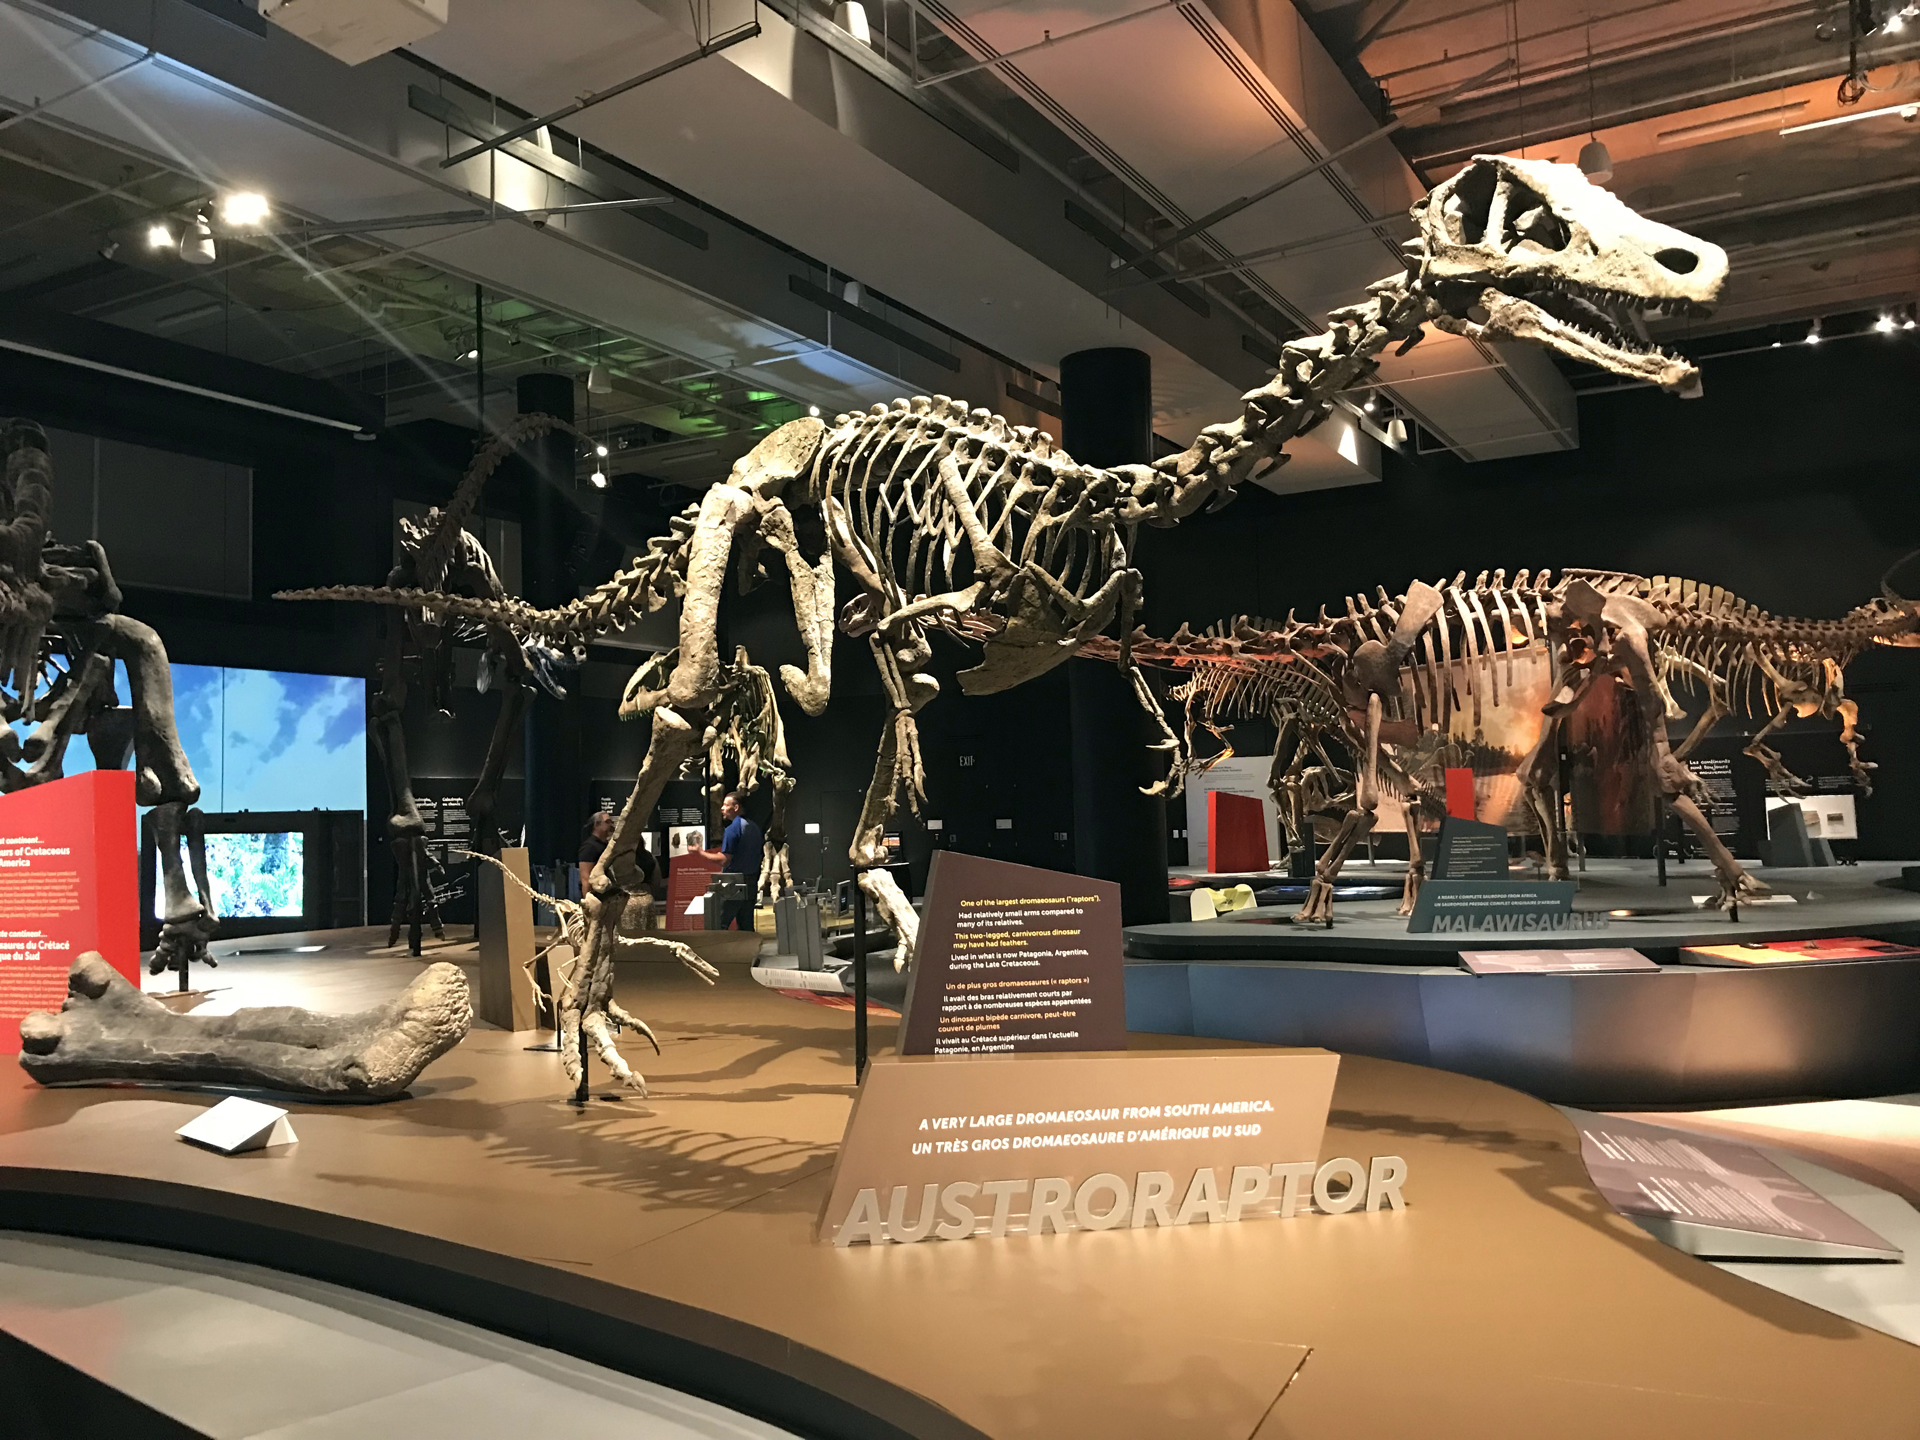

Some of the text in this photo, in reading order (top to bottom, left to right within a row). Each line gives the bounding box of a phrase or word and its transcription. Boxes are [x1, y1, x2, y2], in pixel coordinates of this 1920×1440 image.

[959, 755, 973, 766] EXIT
[15, 847, 24, 856] of
[25, 847, 70, 856] Cretaceous
[996, 899, 1018, 907] largest
[973, 911, 1003, 919] relatively
[1041, 908, 1074, 917] compared
[1432, 912, 1610, 933] MALAWISAURUS
[970, 931, 1010, 940] two-legged,
[26, 940, 36, 949] du
[38, 940, 69, 950] Crétacé
[13, 951, 23, 960] du
[25, 951, 40, 961] Sud
[1019, 950, 1053, 959] Patagonia,
[1054, 949, 1088, 958] Argentina,
[949, 963, 971, 971] during
[967, 982, 981, 990] plus
[982, 982, 997, 990] gros
[1058, 978, 1082, 986] raptors
[1061, 990, 1072, 998] par
[942, 1004, 967, 1013] rapport
[1024, 1000, 1050, 1008] espèces
[1051, 998, 1091, 1007] apparentées
[985, 1014, 1008, 1022] bipède
[1044, 1011, 1076, 1020] peut-être
[975, 1024, 1000, 1032] plumes
[998, 1034, 1030, 1043] supérieur
[934, 1046, 970, 1054] Patagonie,
[981, 1043, 1014, 1053] Argentine
[919, 1100, 1274, 1130] A VERY LARGE DROMAEOSAUR FROM SOUTH AMERICA.
[912, 1123, 1261, 1154] UN TRÈS GROS DROMAEOSAURE D'AMÉRIQUE DU SUD
[834, 1156, 1408, 1247] AUSTRORAPTOR
